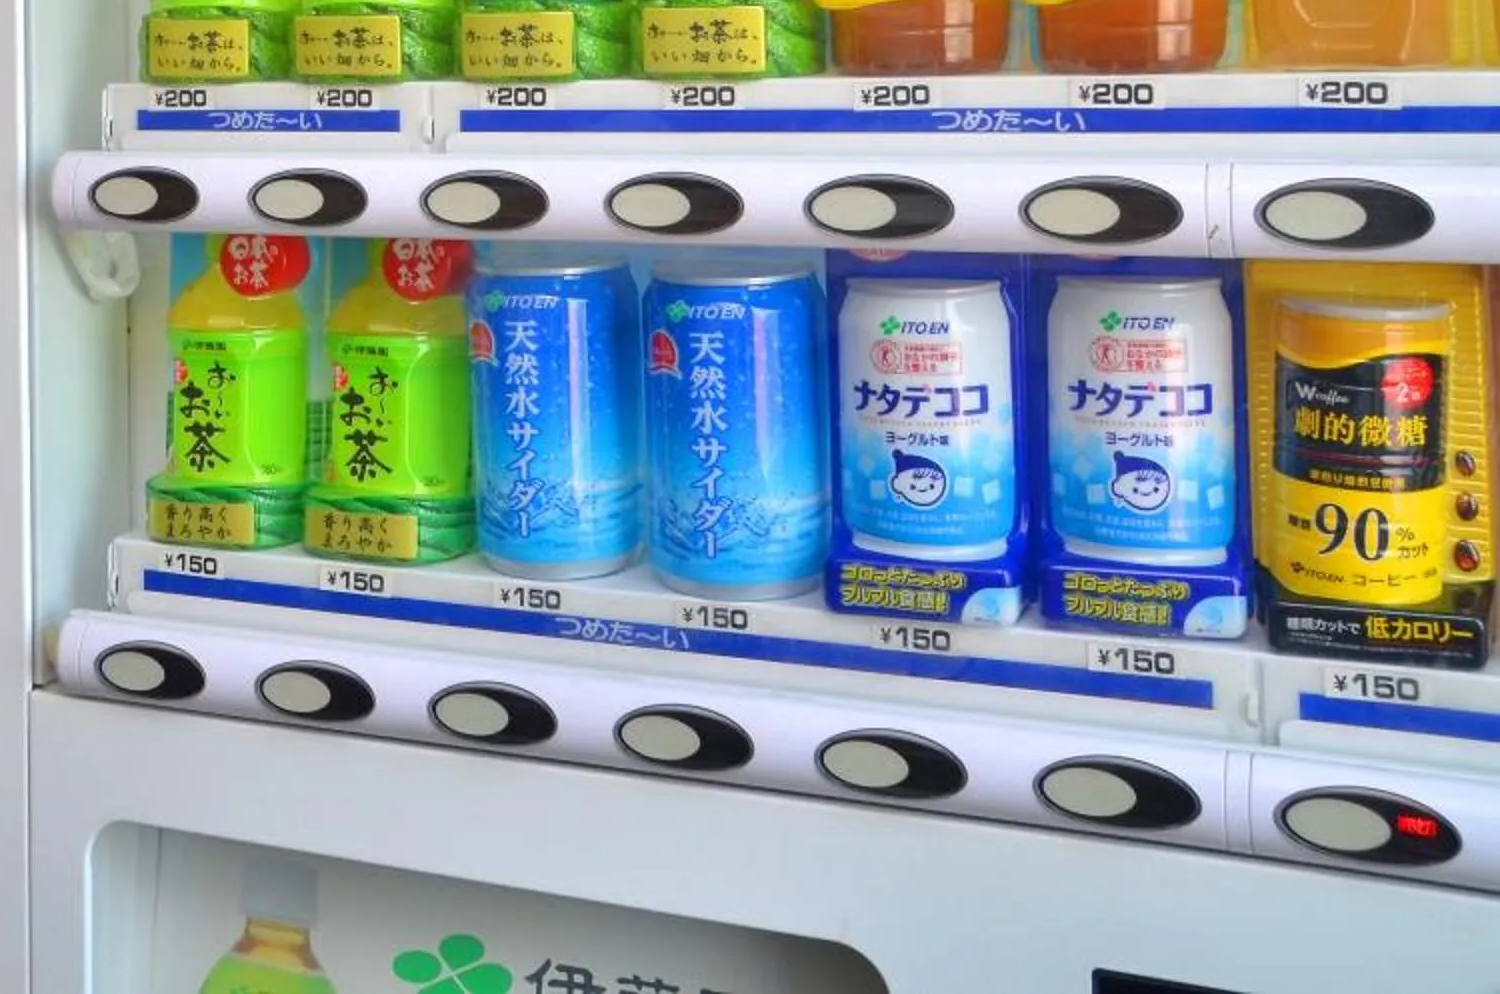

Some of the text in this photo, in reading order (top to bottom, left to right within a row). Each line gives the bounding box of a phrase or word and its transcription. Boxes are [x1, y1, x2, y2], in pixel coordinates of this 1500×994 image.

[155, 89, 207, 108] ¥200
[317, 89, 373, 108] ¥200
[486, 86, 548, 107] ¥200
[671, 85, 736, 107] ¥200
[860, 85, 930, 107] ¥200
[1078, 83, 1154, 105] ¥200
[1306, 81, 1389, 105] ¥200
[853, 379, 989, 418] ナタデココ
[1068, 379, 1213, 418] ナタデココ
[179, 380, 232, 473] お茶
[339, 386, 393, 484] お茶
[504, 319, 544, 538] 天然水サイダー
[1293, 407, 1429, 447] 劇的微糖
[689, 331, 731, 560] 天然水サイダー
[1314, 503, 1390, 562] 90
[163, 552, 218, 577] ¥150
[327, 569, 386, 594] ¥150
[499, 587, 562, 610] ¥150
[682, 606, 749, 631] ¥150
[1364, 614, 1474, 643] 低カロリー
[880, 626, 951, 652] ¥150
[1098, 647, 1176, 675] ¥150
[1333, 672, 1420, 702] ¥150
